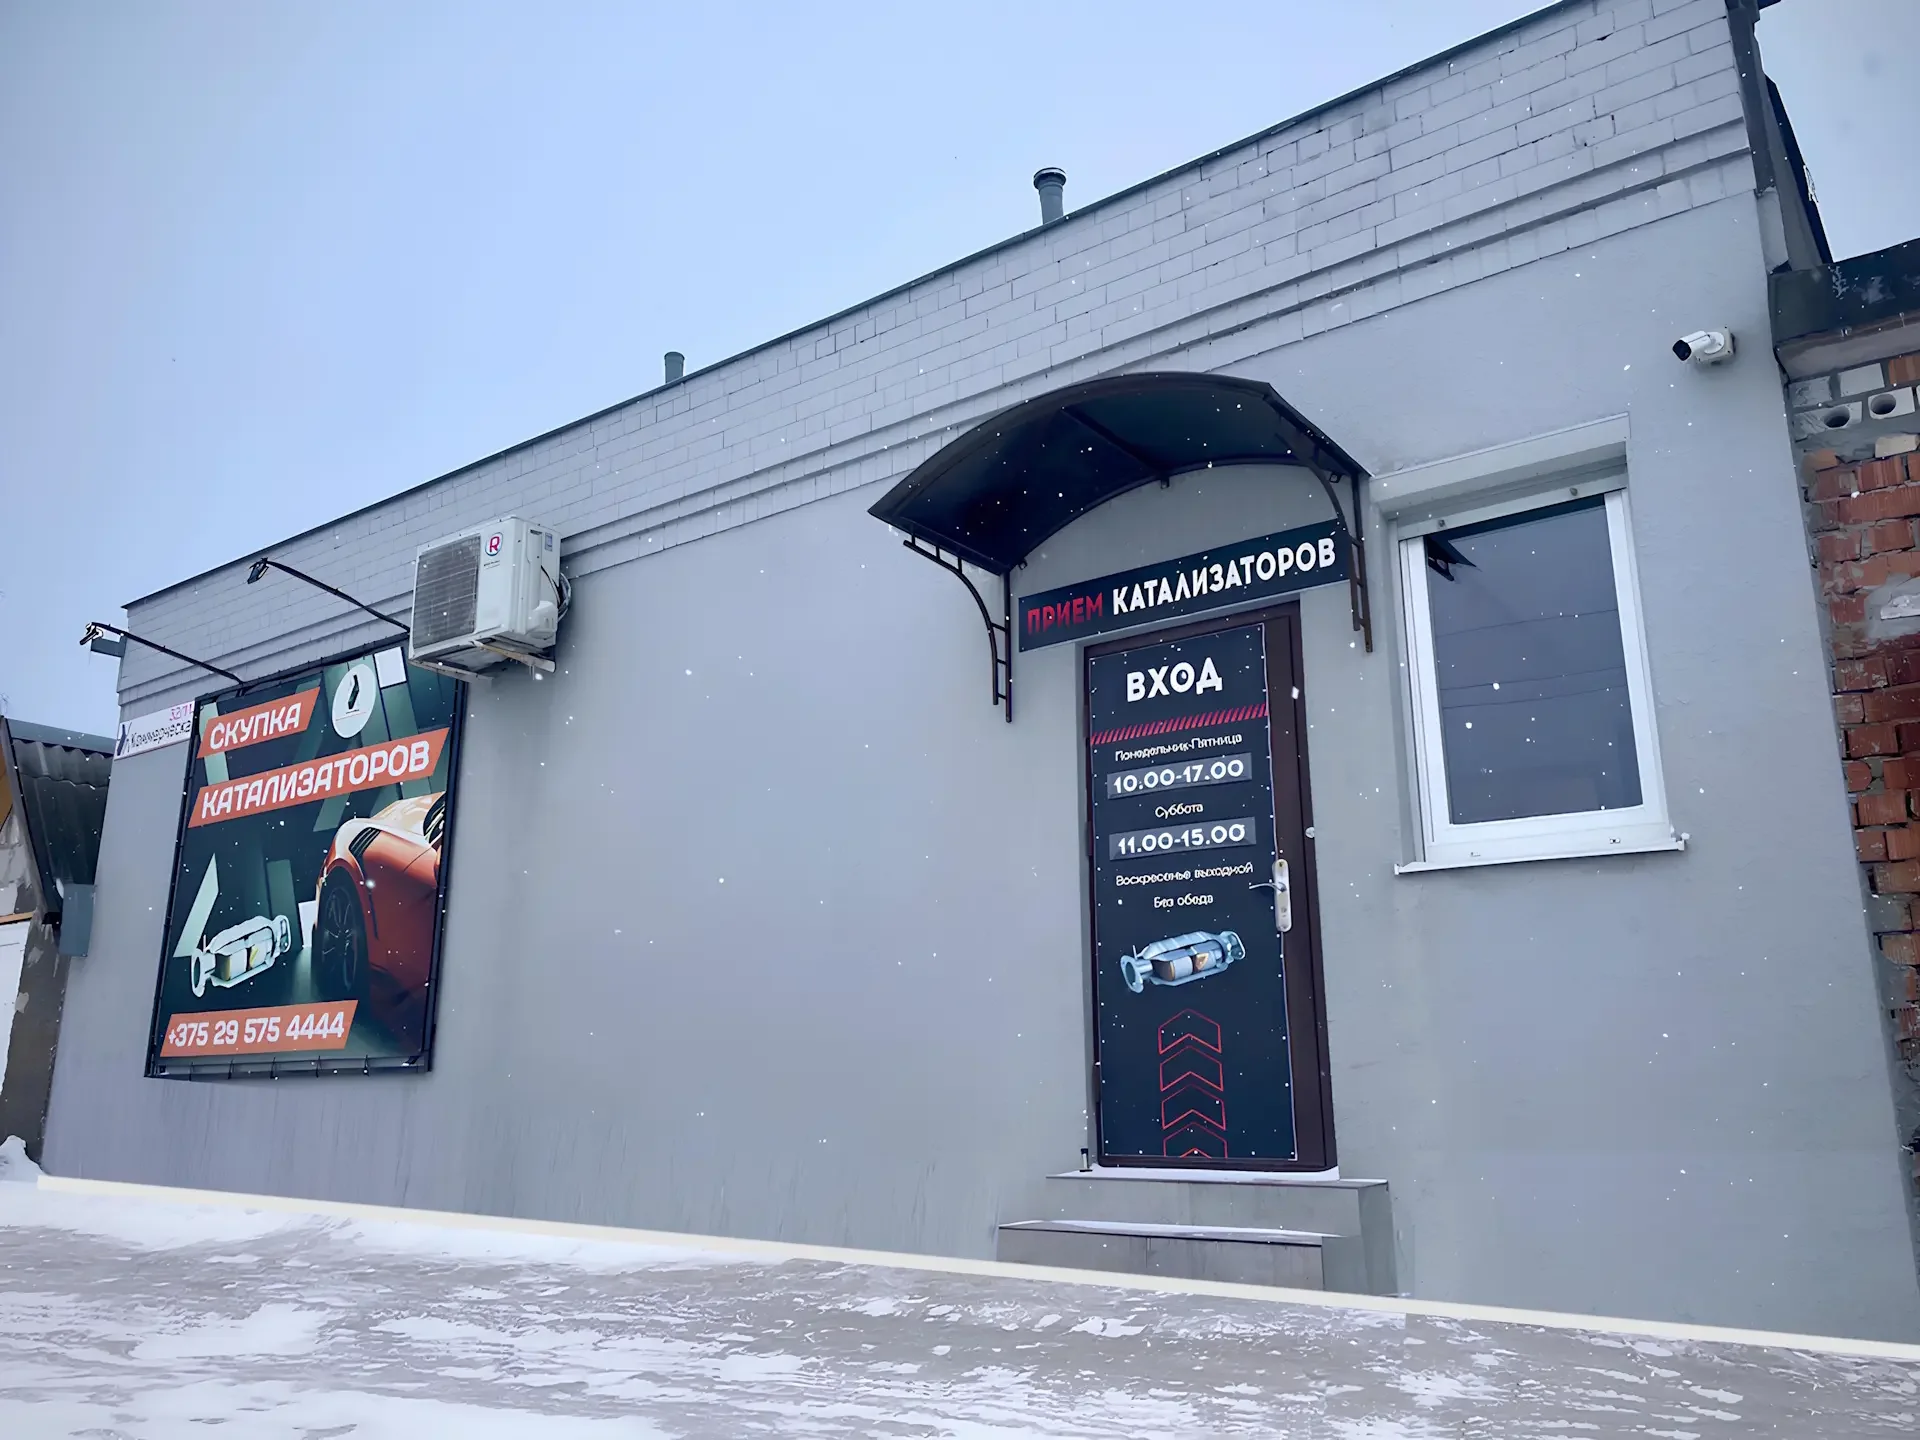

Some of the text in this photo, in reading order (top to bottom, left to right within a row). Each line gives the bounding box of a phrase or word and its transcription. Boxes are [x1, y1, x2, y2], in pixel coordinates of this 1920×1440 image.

[1027, 537, 1336, 635] ПРИЕМ КАТАЛИЗАТОРОВ
[1126, 657, 1223, 703] ВХОД
[209, 702, 302, 750] СКУПКА
[201, 740, 431, 819] КАТАЛИЗАТОРОВ
[1154, 803, 1204, 820] Суббота
[1117, 823, 1246, 855] 11.00-15.00
[1176, 893, 1214, 906] обеда
[168, 1011, 345, 1047] +375 29 575 4444
